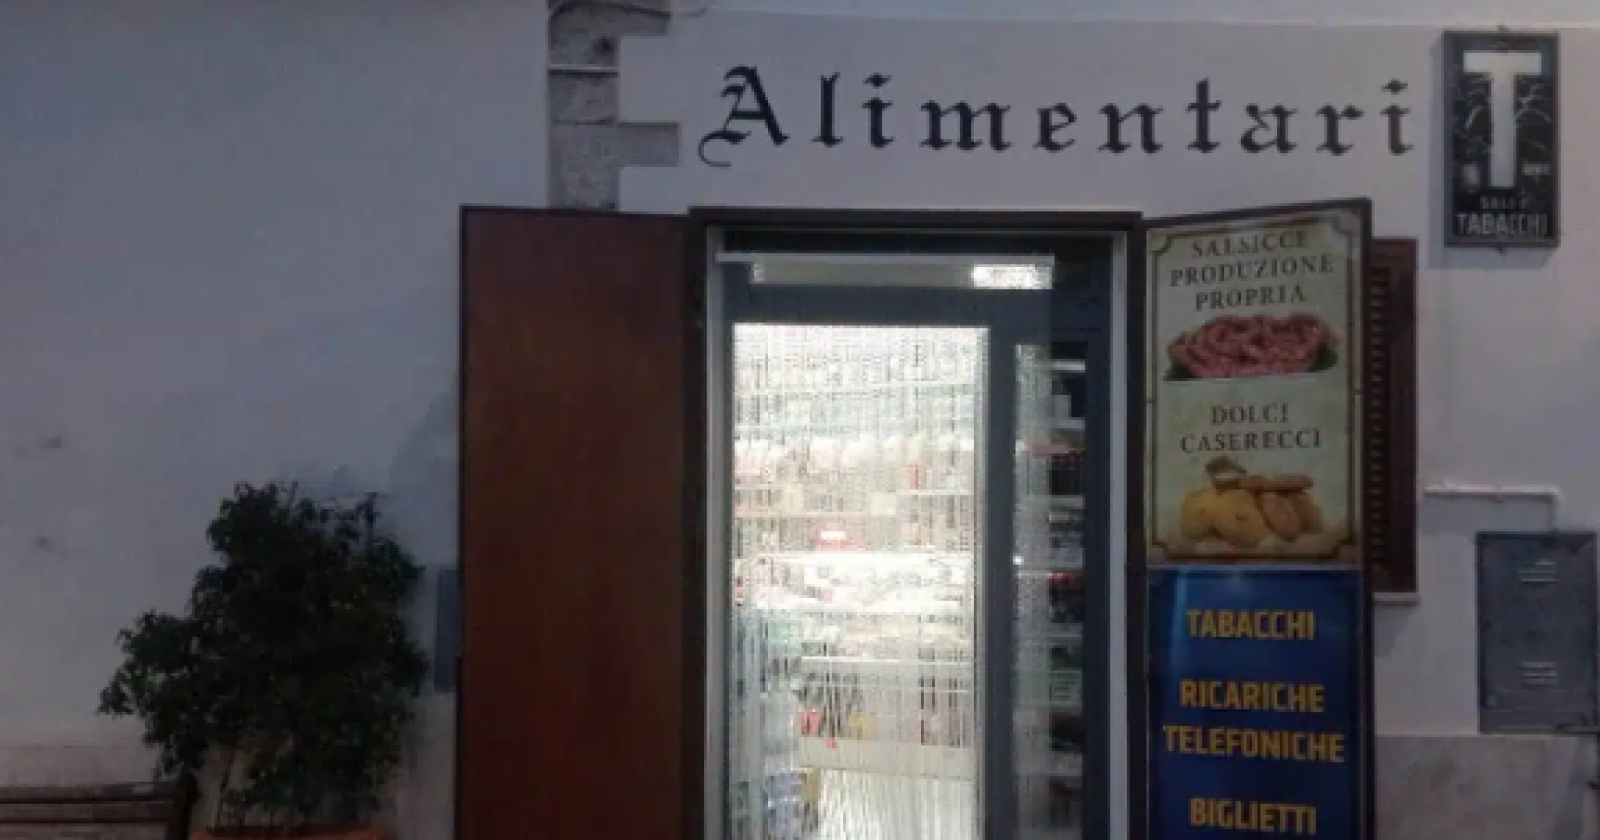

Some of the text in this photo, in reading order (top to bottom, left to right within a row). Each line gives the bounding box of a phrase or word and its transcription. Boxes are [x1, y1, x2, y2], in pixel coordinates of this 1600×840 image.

[698, 66, 1414, 167] Alimentari
[1456, 212, 1549, 236] TABACCHI
[1191, 230, 1306, 257] SALSICCE
[1170, 254, 1334, 286] PRODUZIONE
[1195, 285, 1305, 311] PROPRIA
[1211, 404, 1288, 425] DOLCI
[1180, 428, 1320, 453] CASERECCI
[1186, 609, 1315, 639] TABACCHI
[1180, 680, 1324, 712] RICARICHE
[1162, 725, 1344, 762] TELEFONICHE
[1190, 798, 1317, 834] BIGLIETTI
